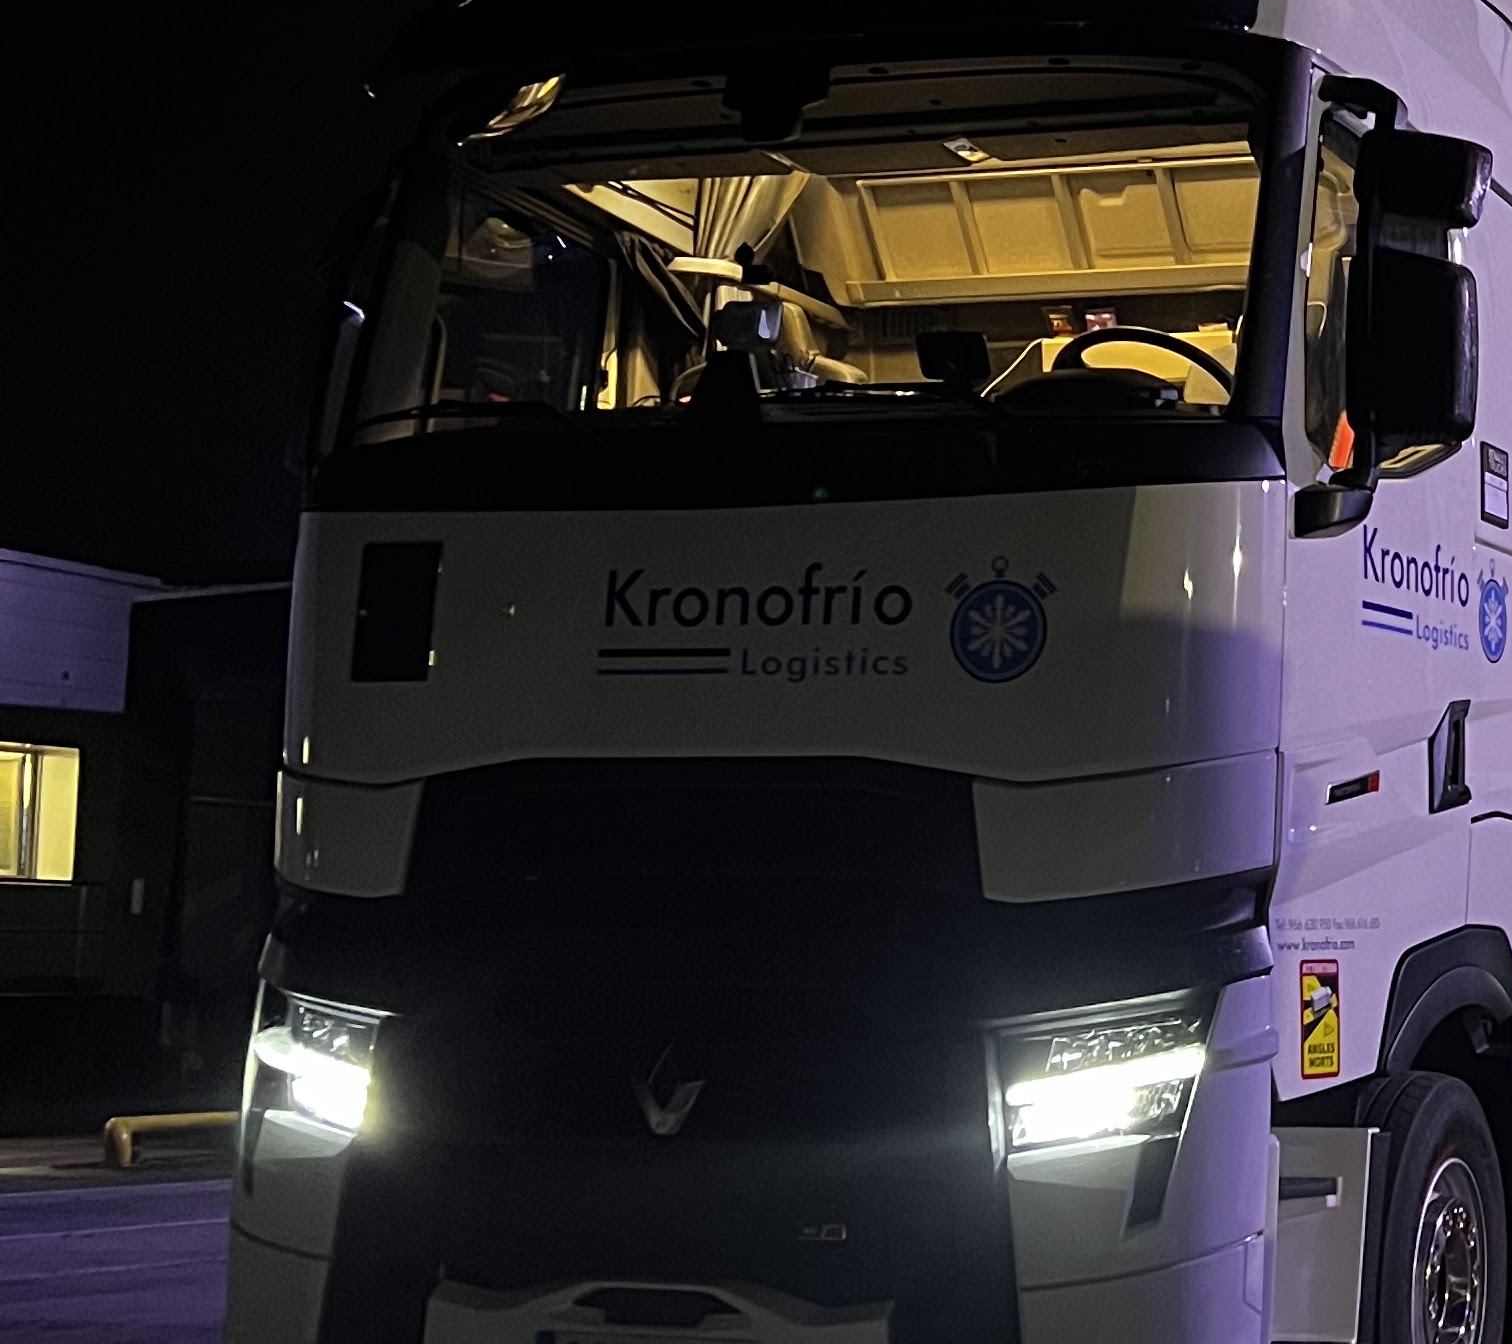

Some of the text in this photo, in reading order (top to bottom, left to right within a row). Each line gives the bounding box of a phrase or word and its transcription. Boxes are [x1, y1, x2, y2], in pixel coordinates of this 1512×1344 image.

[1363, 524, 1470, 608] Kronofrío
[604, 562, 913, 628] Kronofrío
[1415, 614, 1470, 652] Logistics
[740, 648, 910, 684] Logistics
[1308, 1042, 1335, 1055] ANGLES
